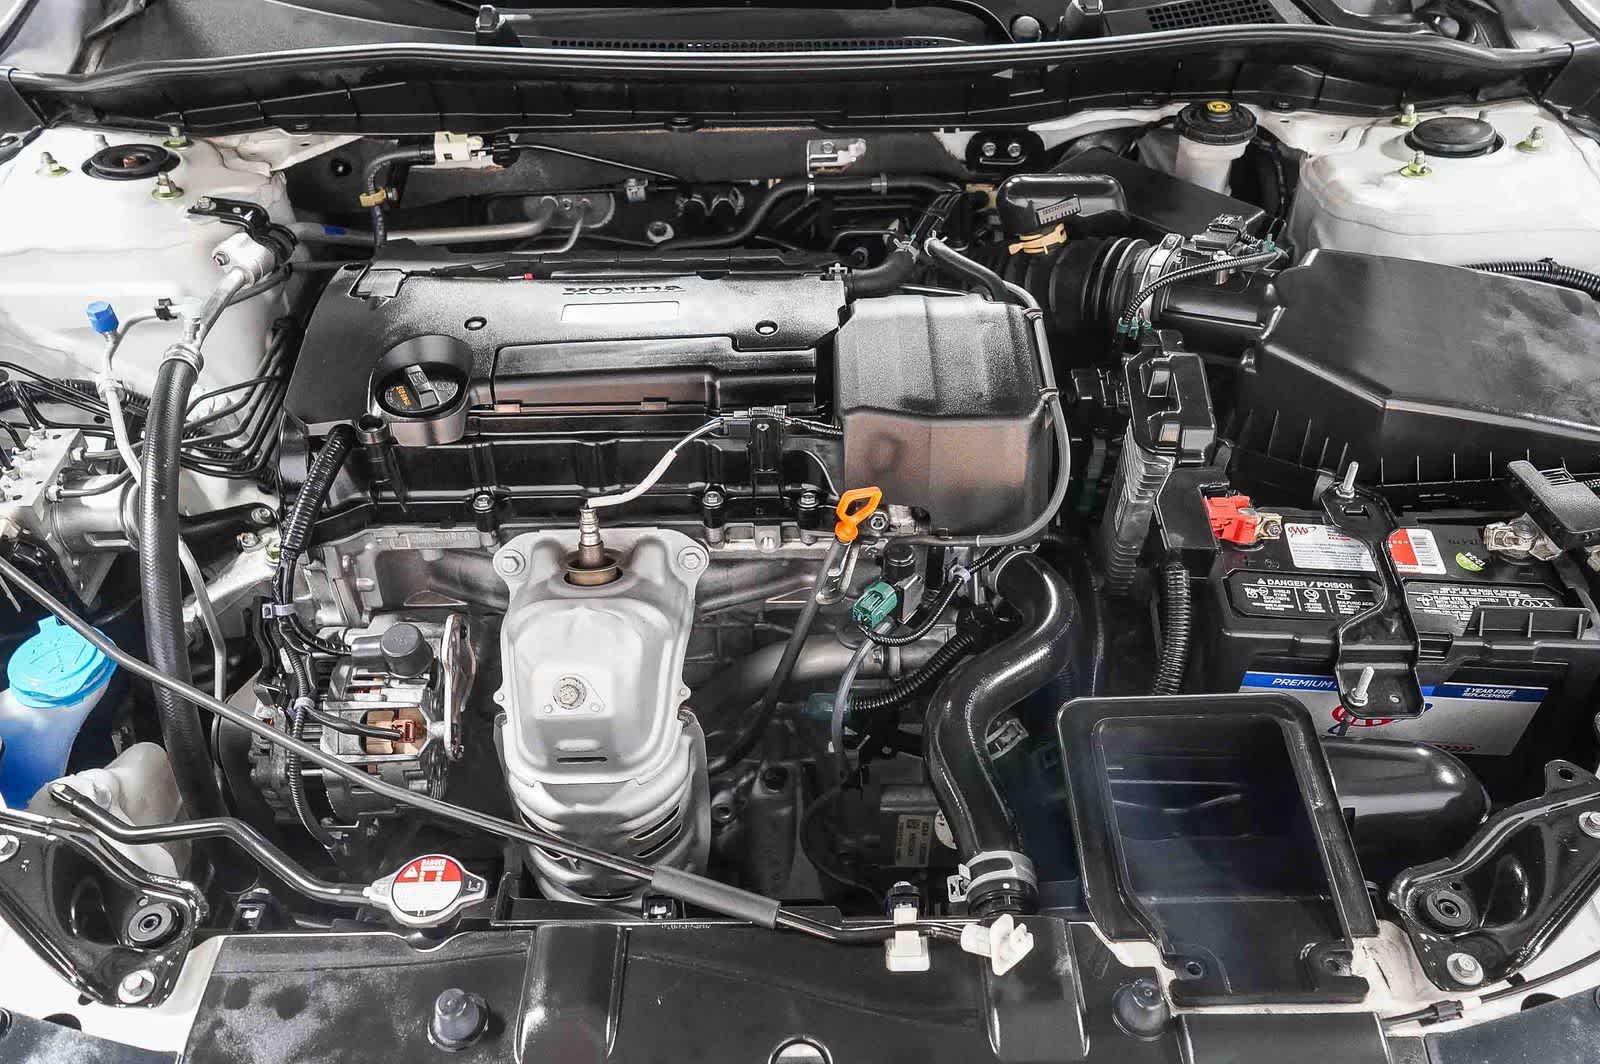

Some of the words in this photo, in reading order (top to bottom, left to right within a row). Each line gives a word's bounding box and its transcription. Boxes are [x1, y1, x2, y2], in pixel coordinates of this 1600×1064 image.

[562, 285, 686, 295] HONDA
[1267, 578, 1306, 587] DANGER
[1317, 581, 1353, 589] POISON
[1272, 678, 1333, 688] PREMIUM
